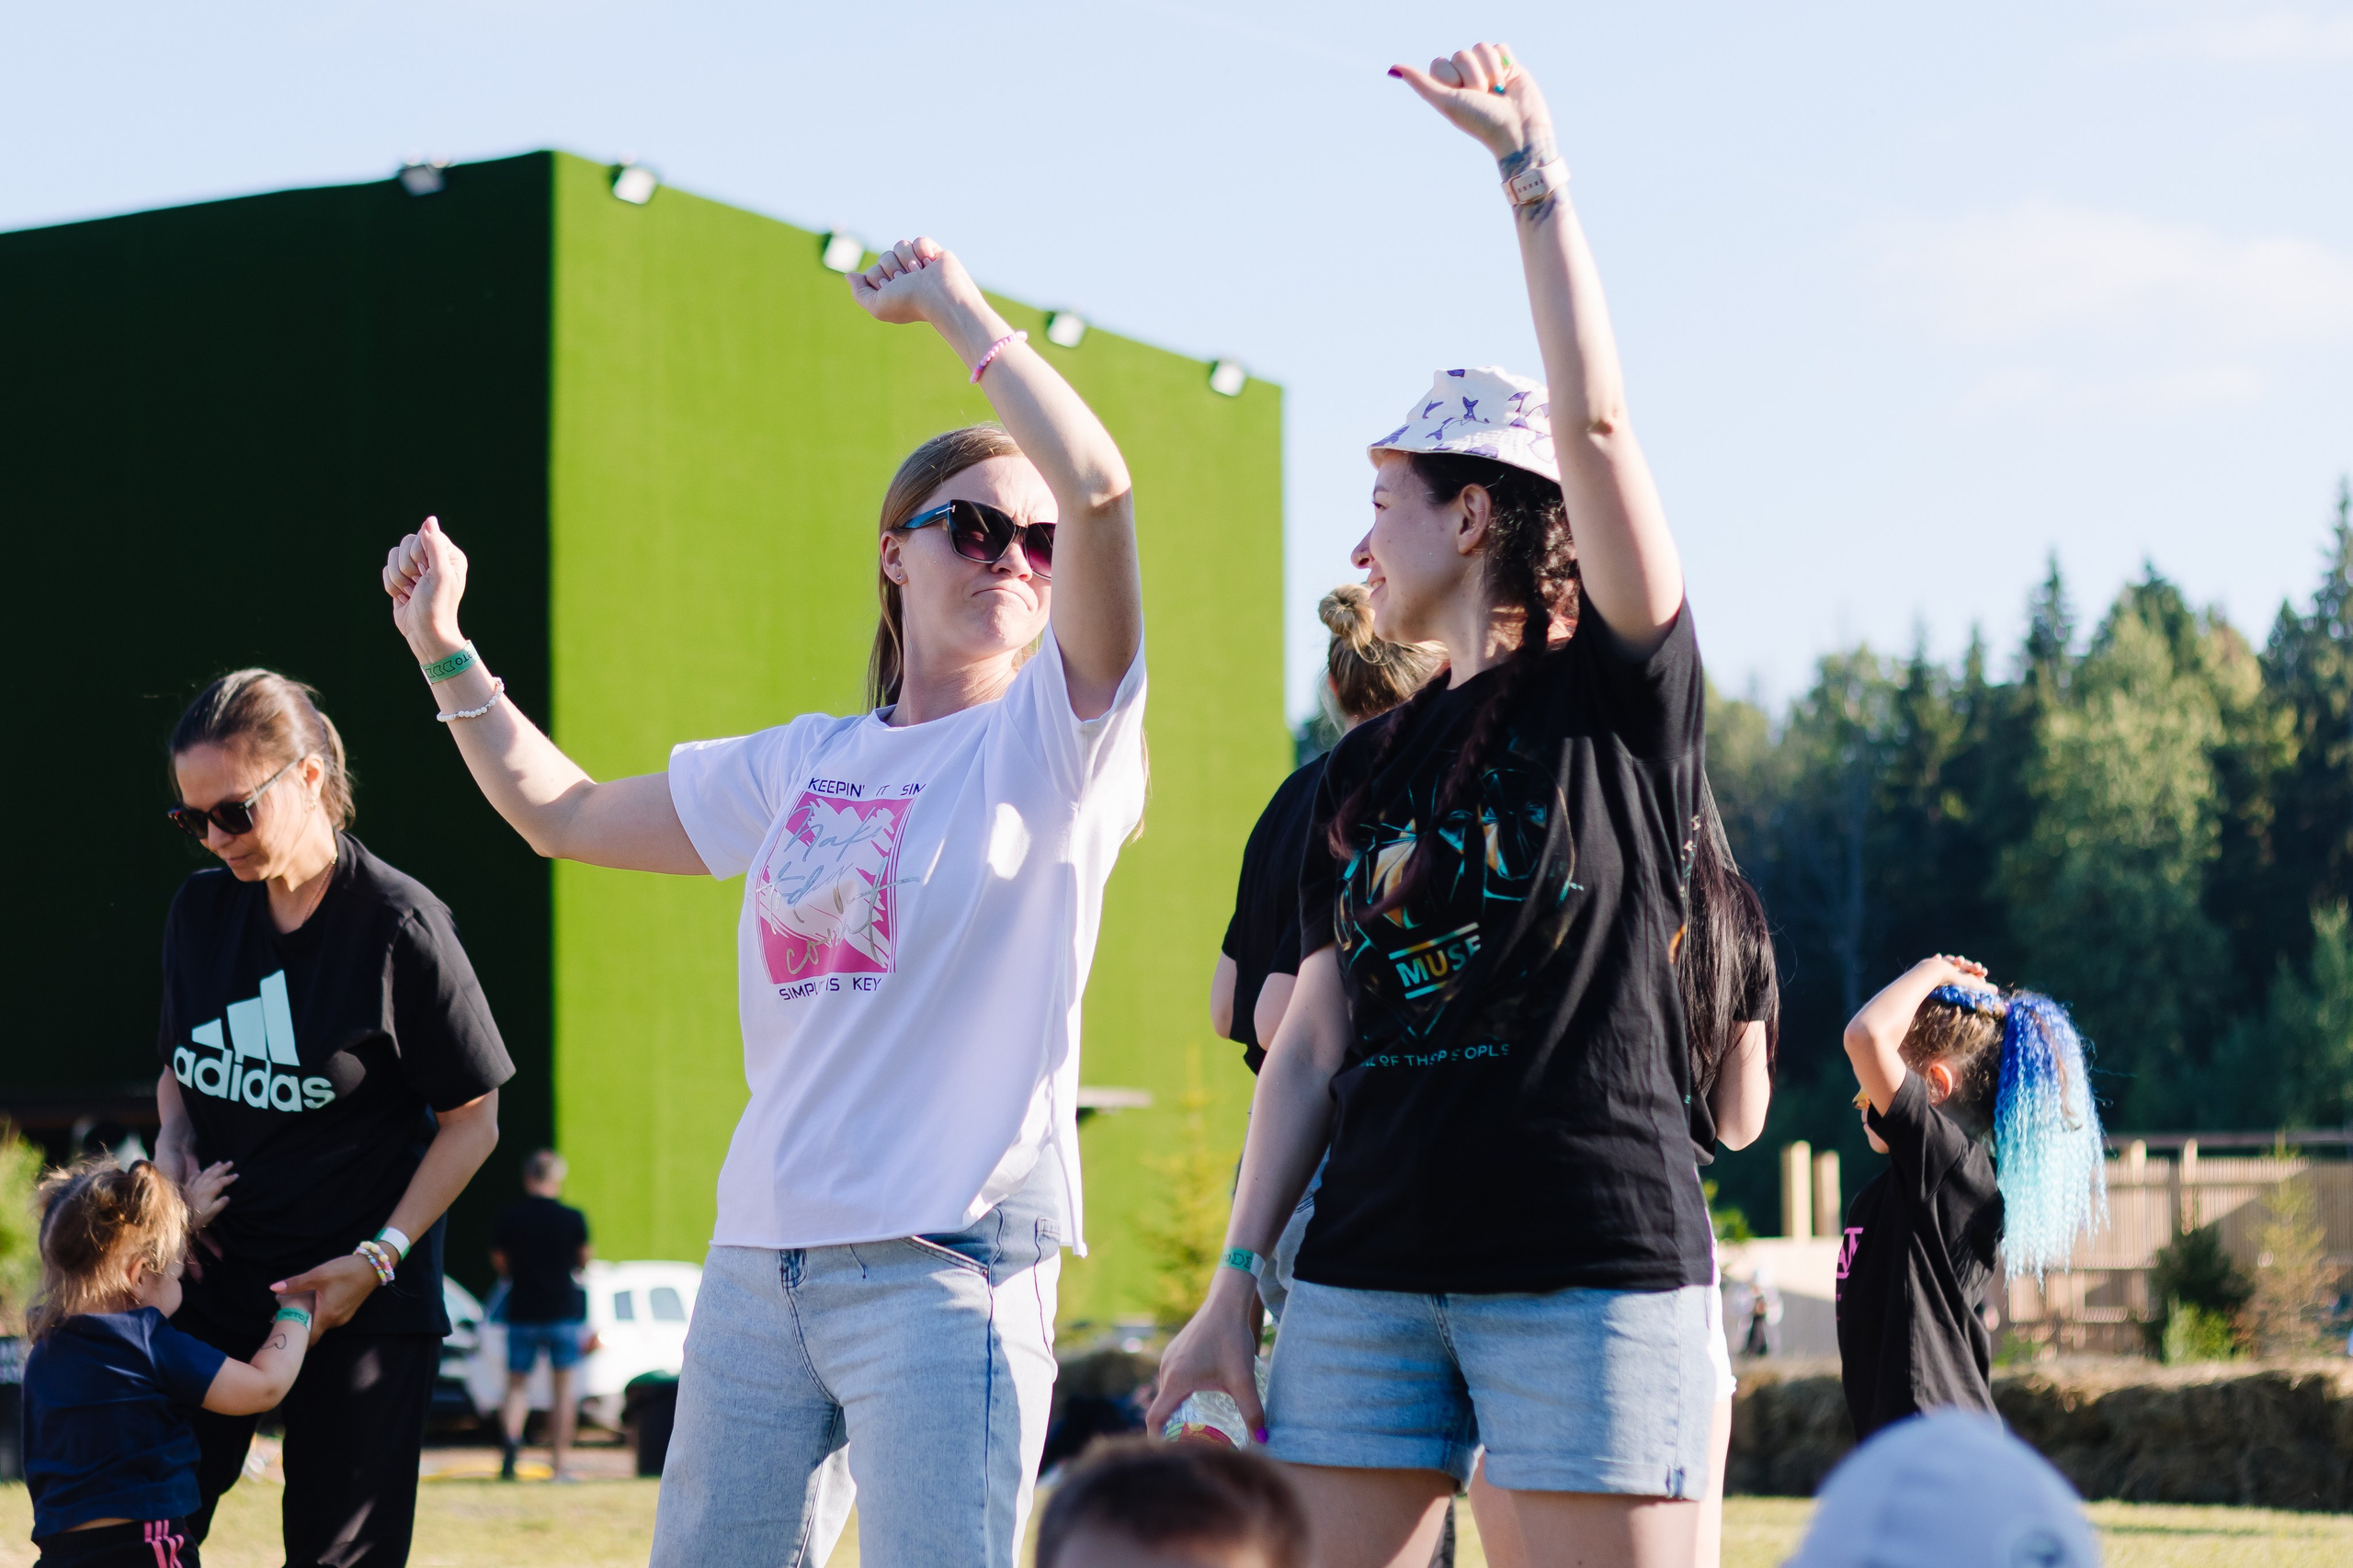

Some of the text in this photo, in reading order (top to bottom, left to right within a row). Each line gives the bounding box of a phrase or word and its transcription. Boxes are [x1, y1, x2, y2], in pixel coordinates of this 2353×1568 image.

[808, 777, 865, 798] KEEPIN'
[1395, 935, 1481, 988] MUSE
[852, 977, 881, 991] KEY
[174, 1046, 336, 1112] adidas
